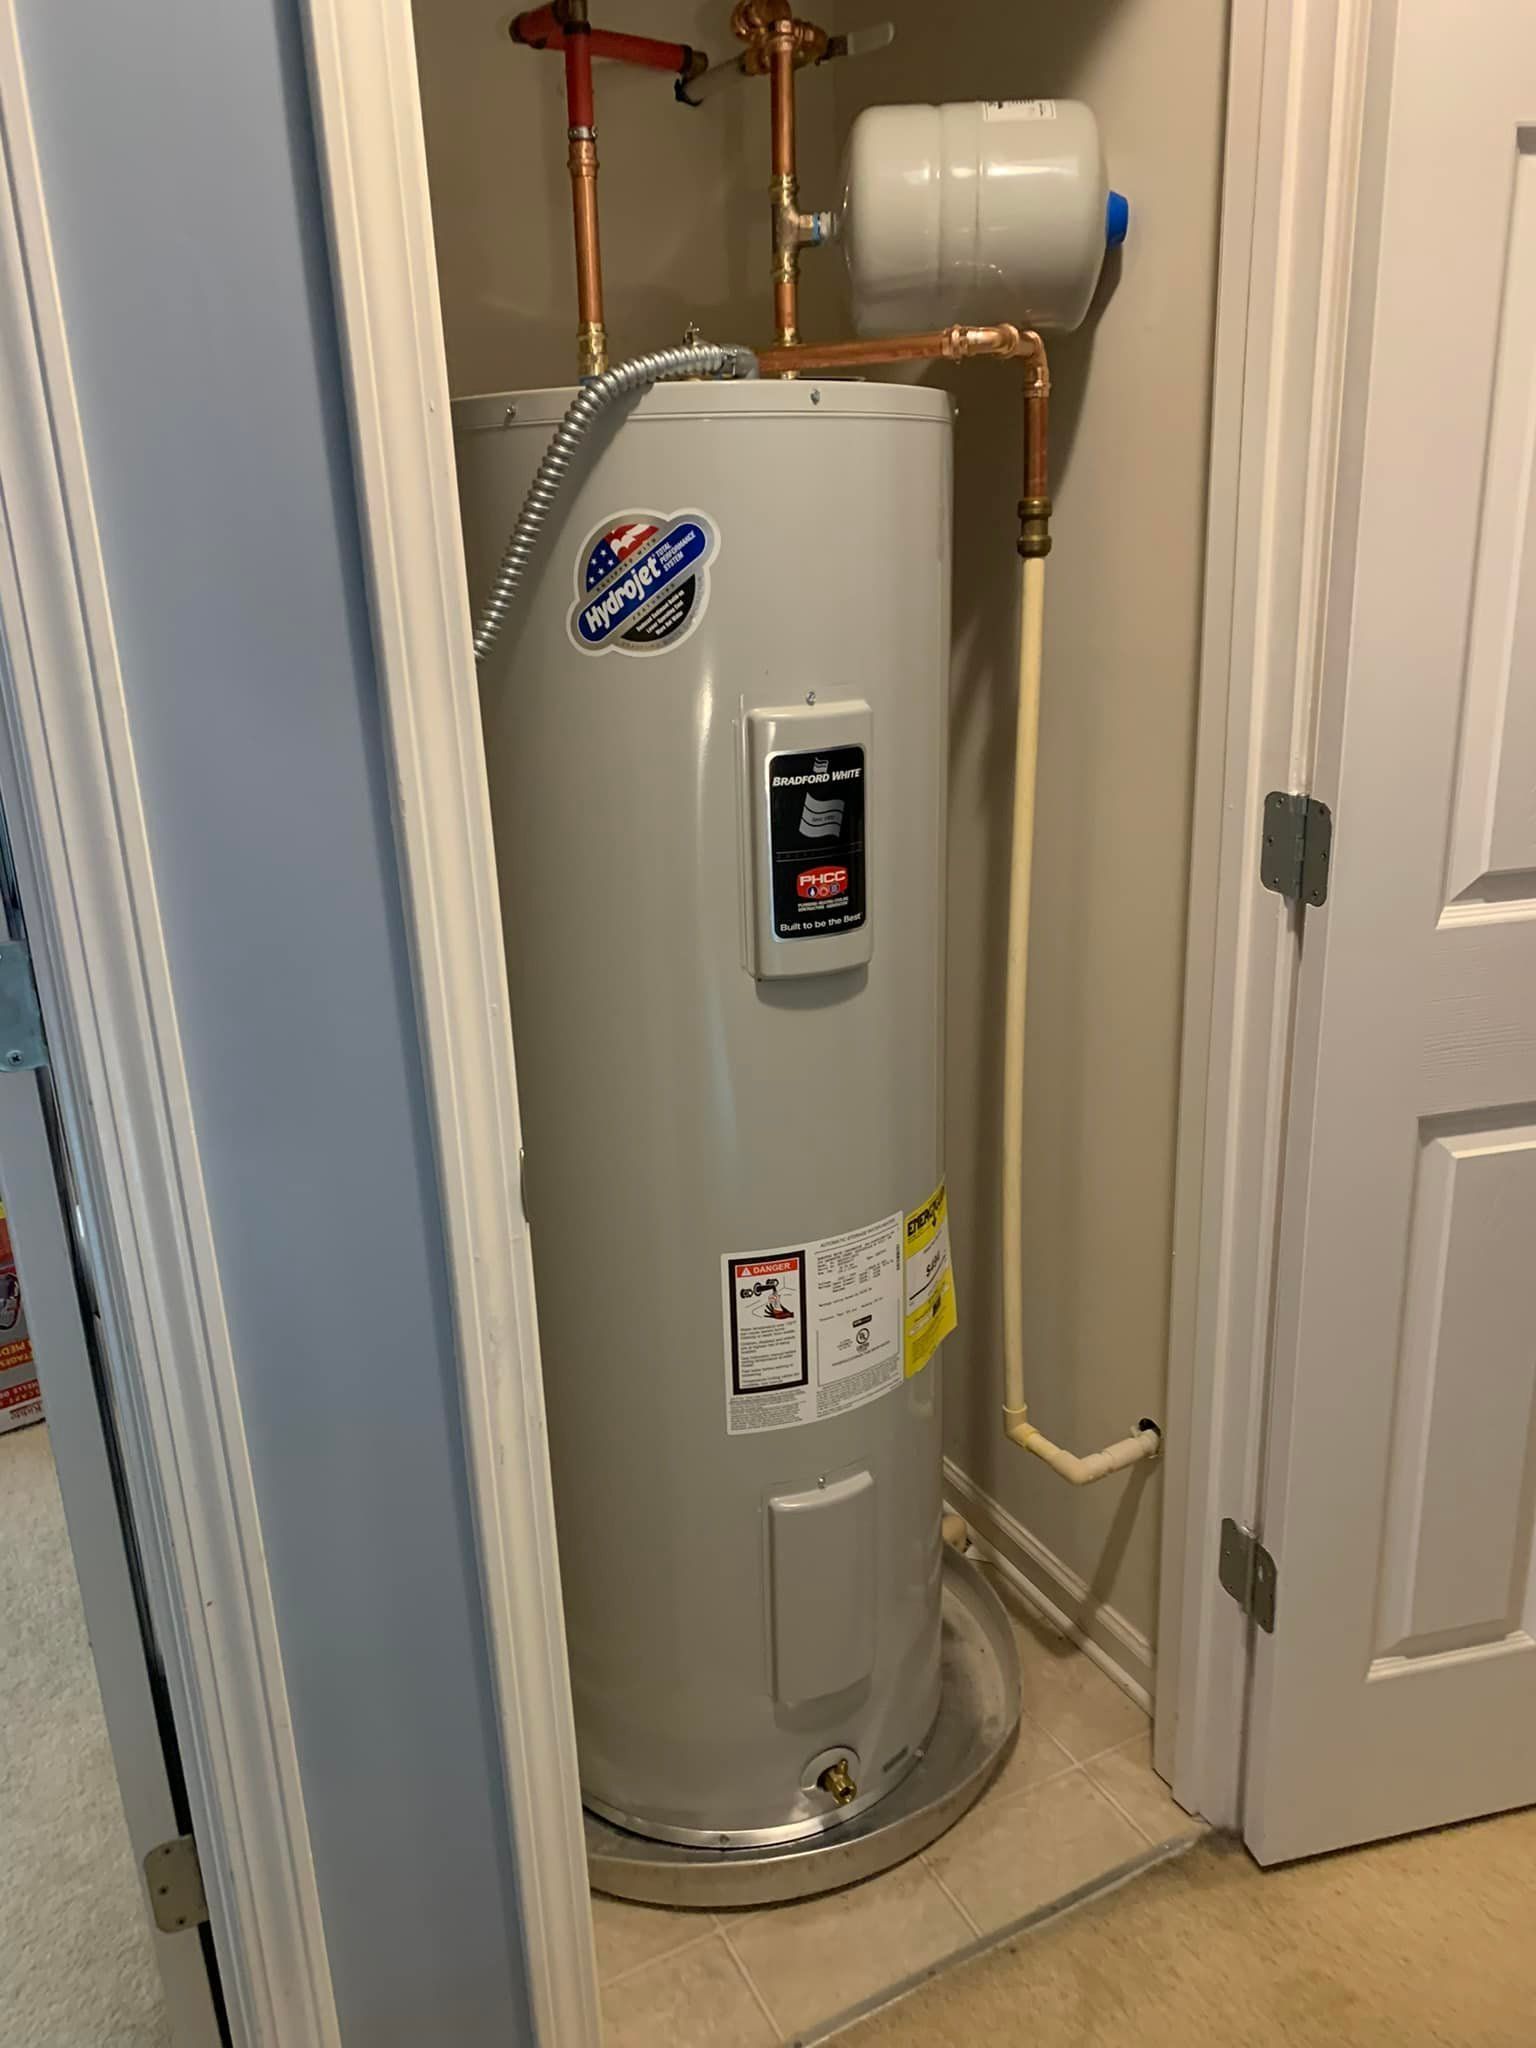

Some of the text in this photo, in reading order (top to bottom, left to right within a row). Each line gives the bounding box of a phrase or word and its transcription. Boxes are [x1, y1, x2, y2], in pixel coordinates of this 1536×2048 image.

[659, 529, 697, 565] PERFORMANCE
[663, 551, 684, 572] SYSTEM
[585, 557, 661, 633] Hydrojet
[773, 768, 861, 787] BRADFORD WHITE
[799, 870, 847, 886] PHCC
[780, 913, 861, 932] Built to be the Best
[753, 1260, 792, 1275] DANGER
